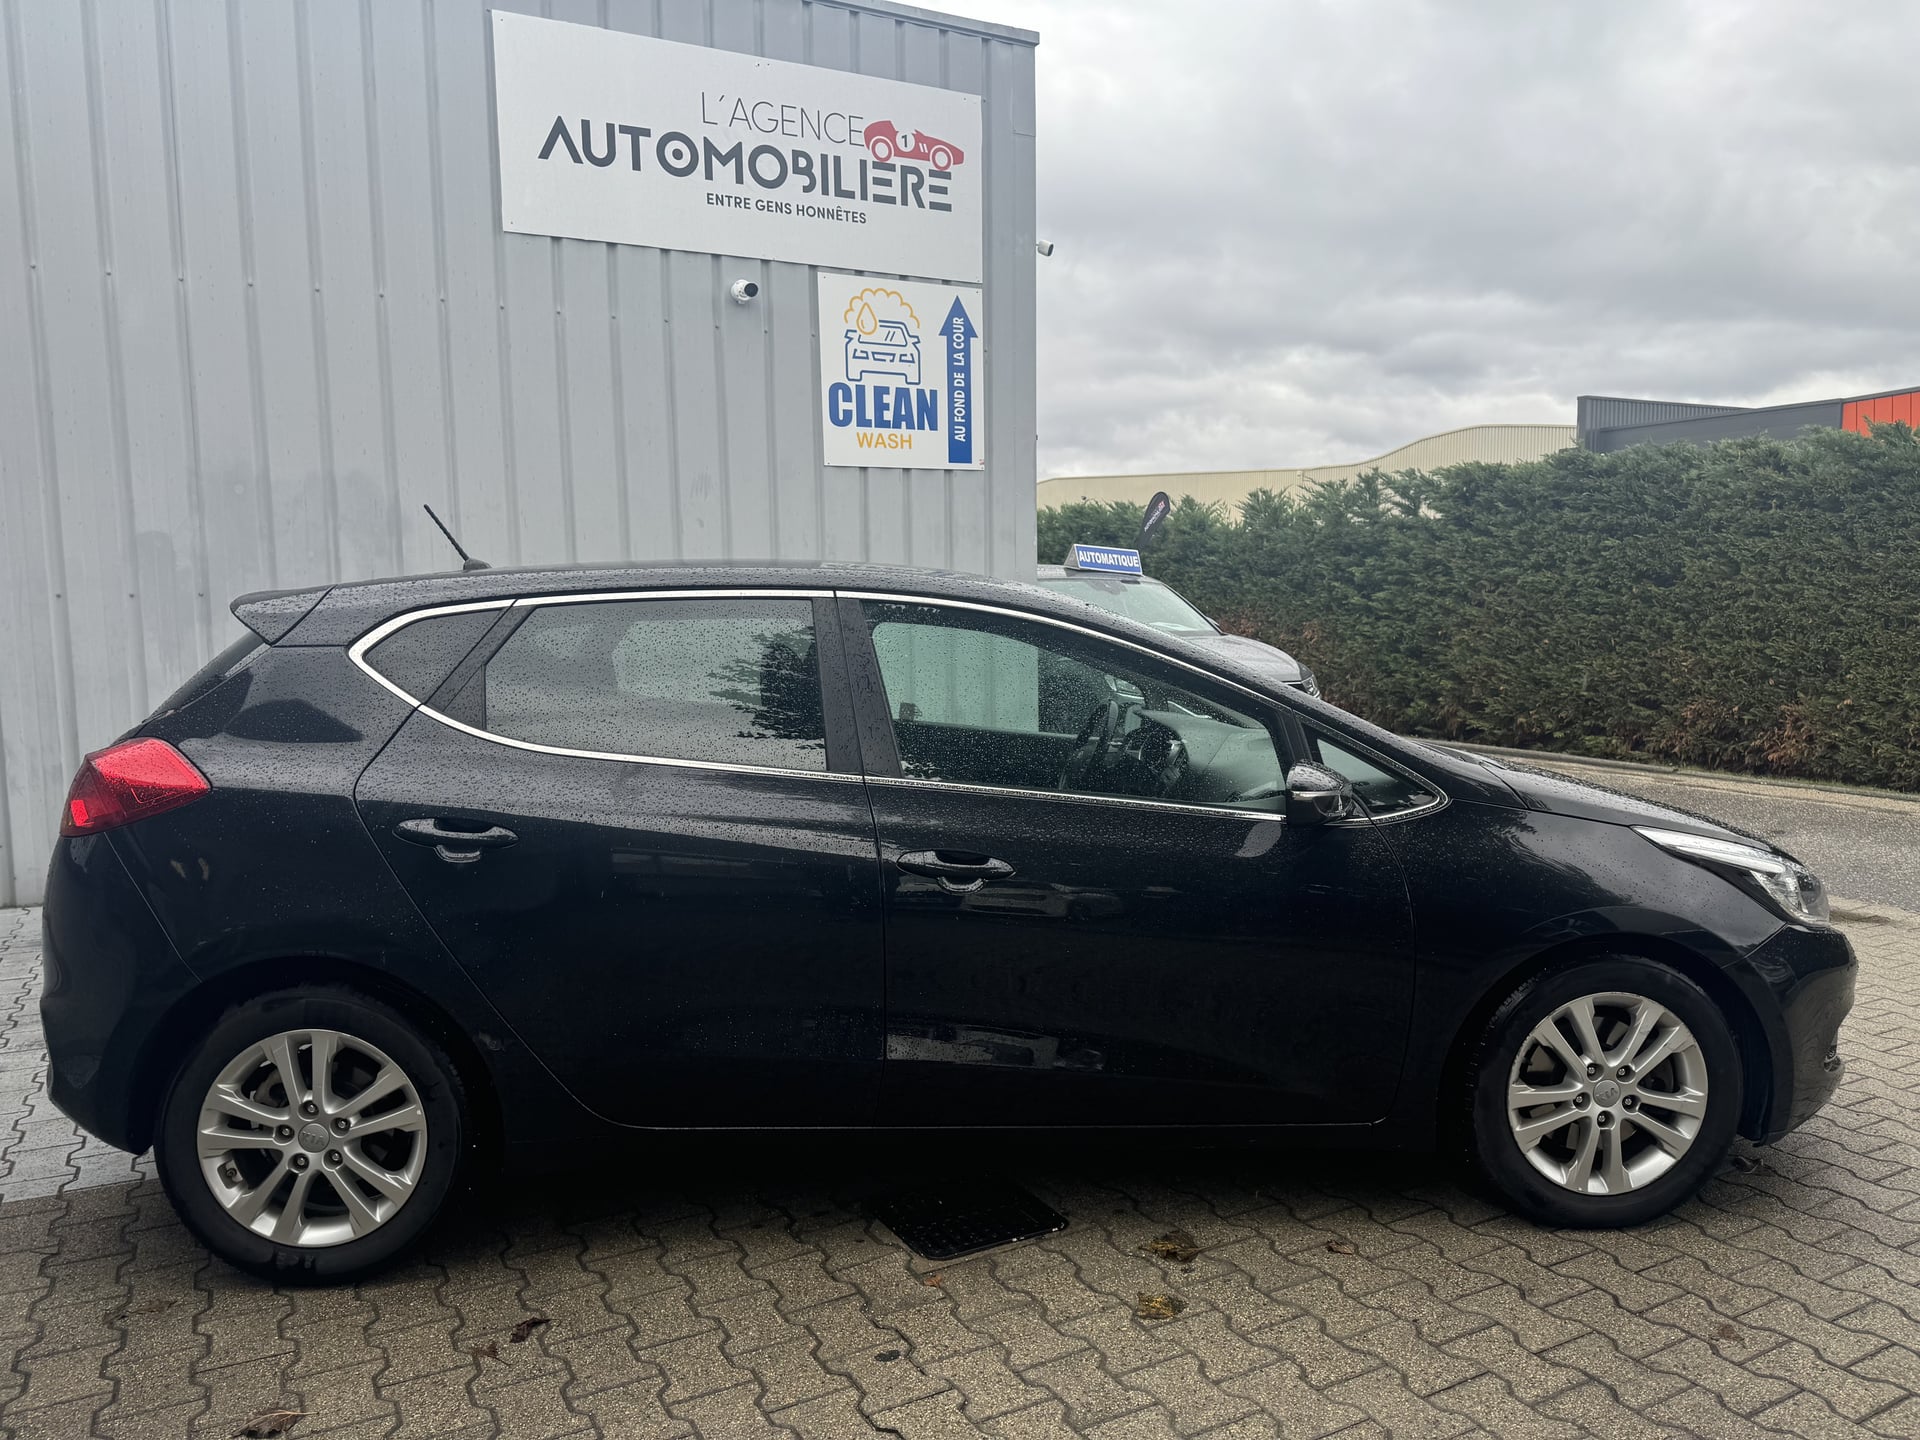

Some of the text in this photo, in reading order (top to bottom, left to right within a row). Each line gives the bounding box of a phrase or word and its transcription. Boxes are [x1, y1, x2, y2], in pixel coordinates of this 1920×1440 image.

[901, 134, 908, 148] 1
[706, 192, 867, 224] ENTRE GENS HONNÊTES
[952, 317, 966, 442] AU FOND DE LA COUR
[828, 381, 938, 431] CLEAN
[856, 431, 912, 449] WASH
[1079, 551, 1139, 567] AUTOMATIQUE
